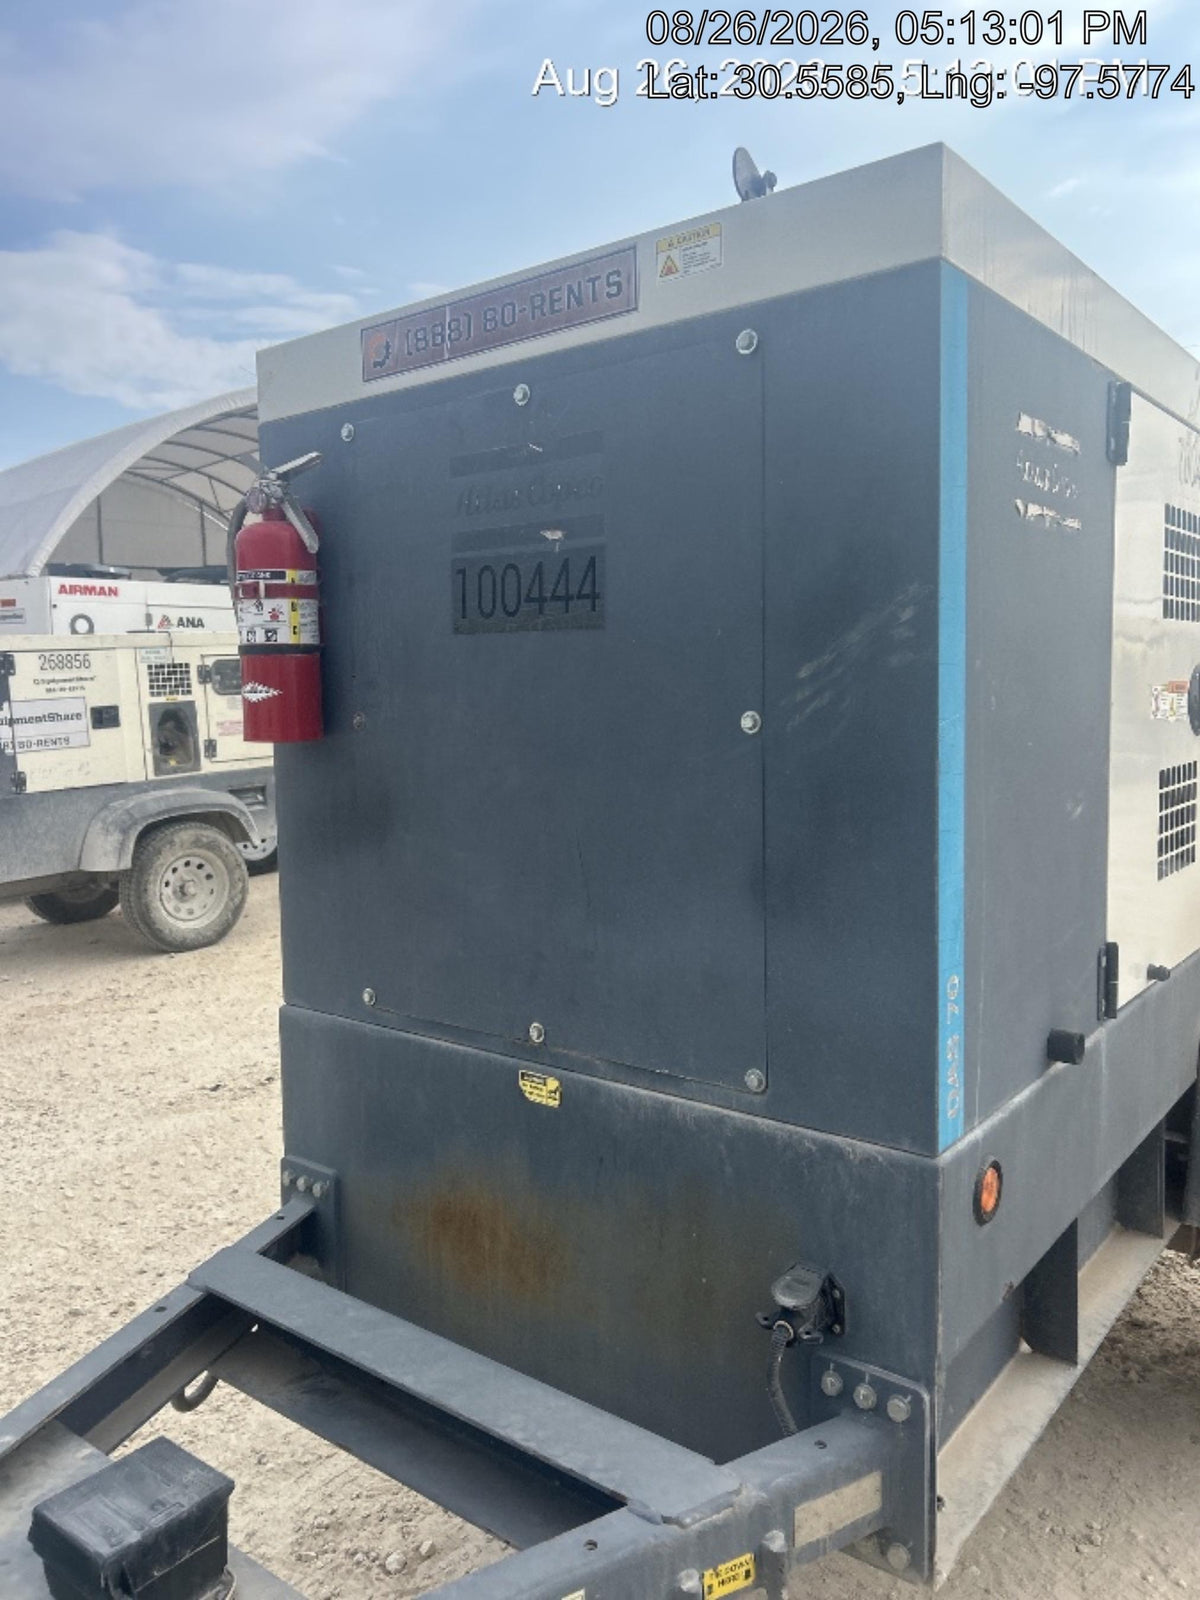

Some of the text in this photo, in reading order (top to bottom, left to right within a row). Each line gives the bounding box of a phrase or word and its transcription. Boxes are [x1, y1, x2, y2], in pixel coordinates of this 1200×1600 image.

[405, 268, 623, 356] (888) 80-RENTS
[58, 584, 118, 597] AIRMAN
[455, 555, 601, 620] 100444
[176, 616, 205, 629] ANA
[38, 653, 92, 671] 268856
